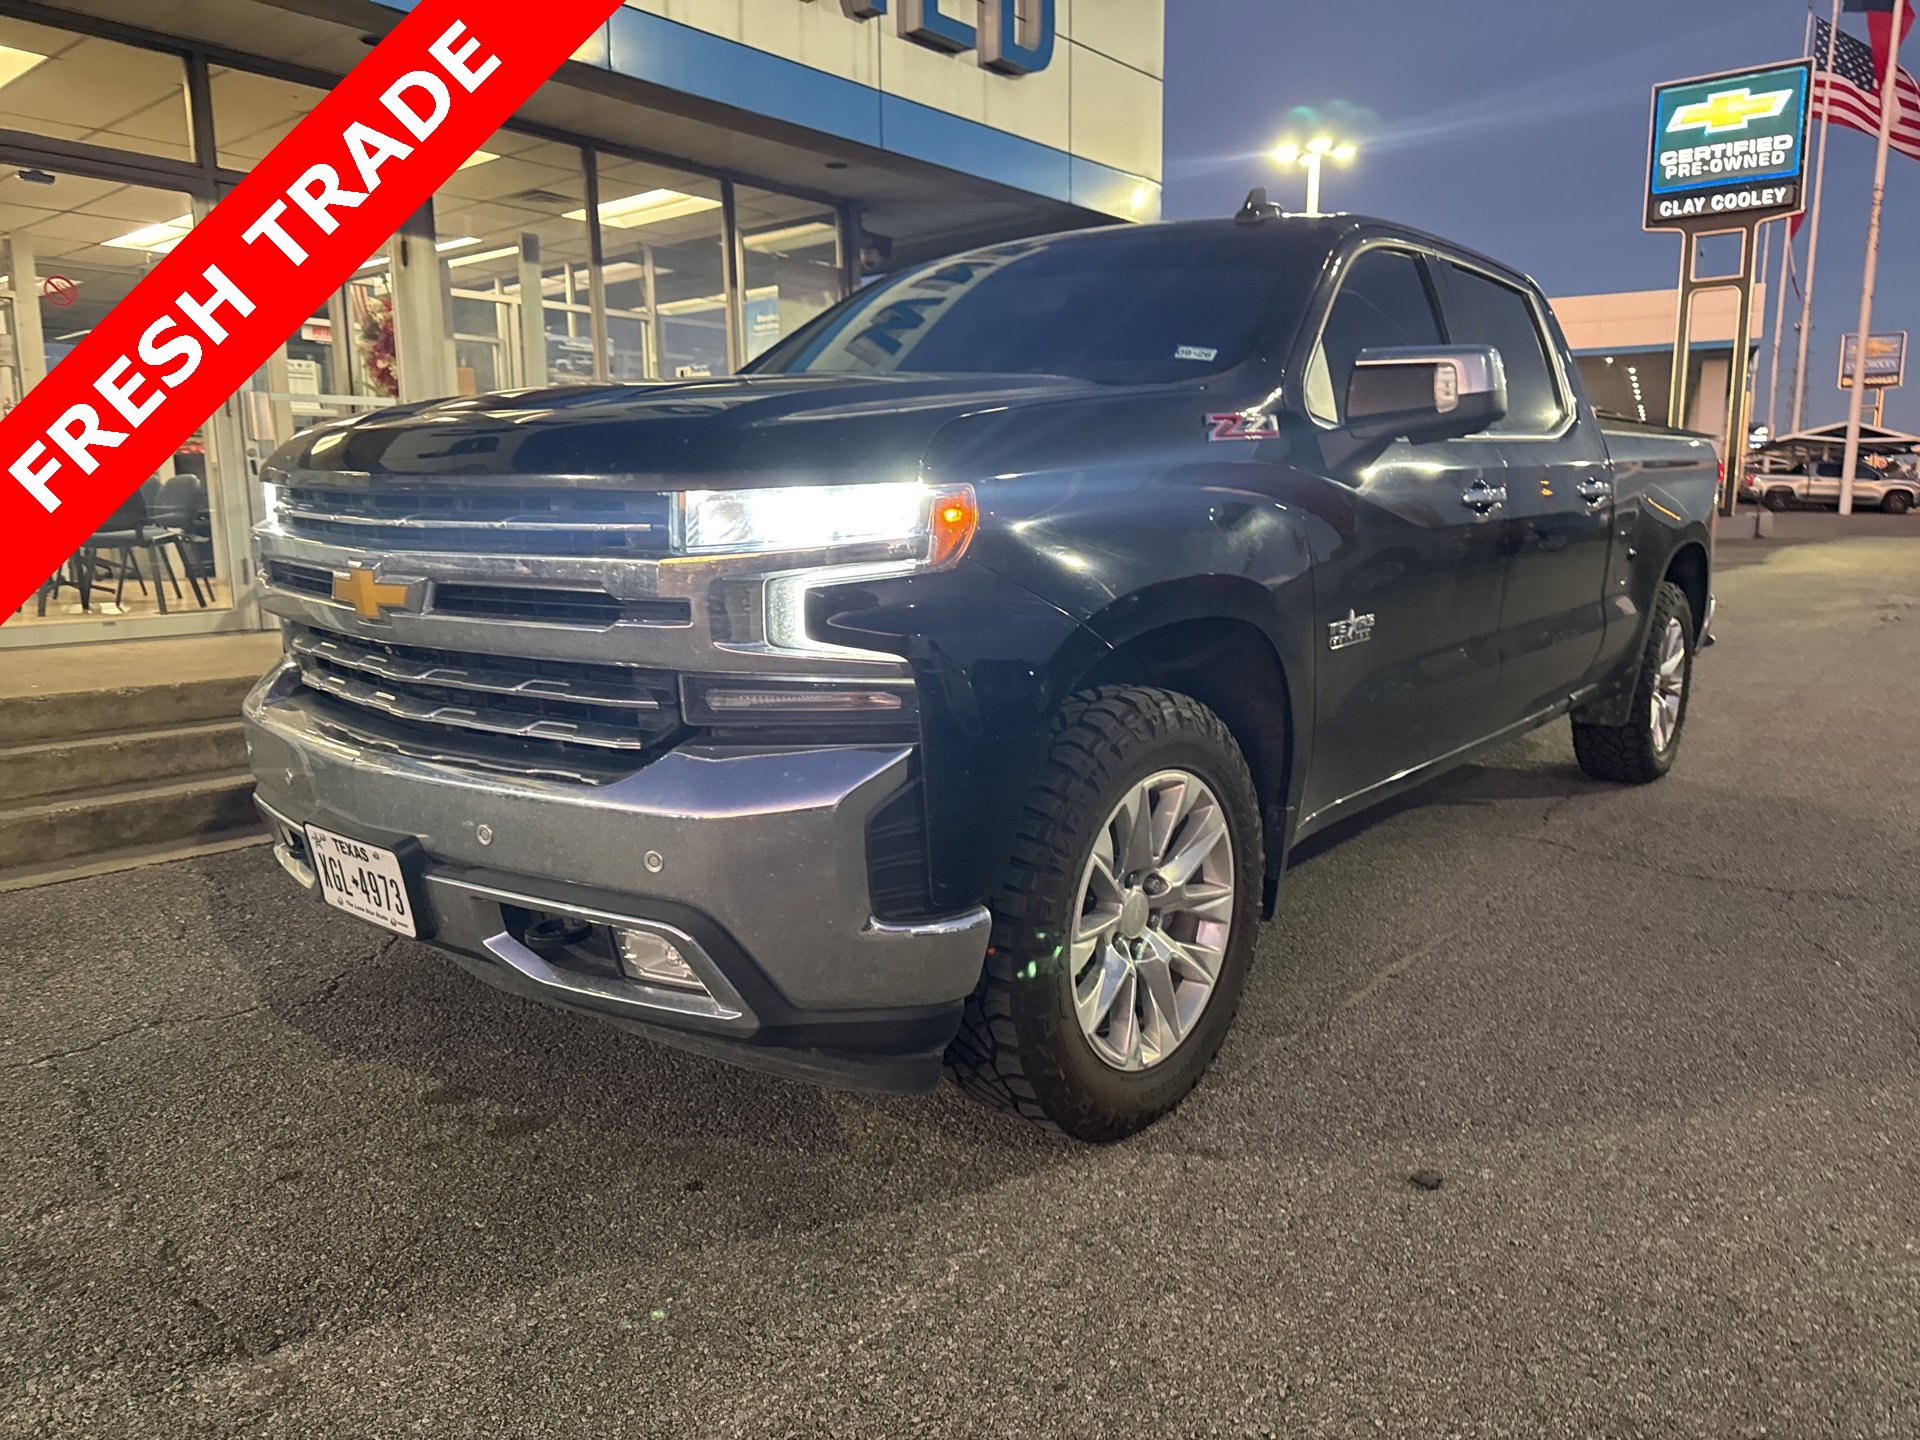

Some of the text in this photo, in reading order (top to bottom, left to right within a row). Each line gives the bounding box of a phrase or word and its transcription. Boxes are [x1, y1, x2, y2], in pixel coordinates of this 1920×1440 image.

[1660, 134, 1794, 166] CERTIFIED
[1665, 150, 1785, 179] PRE-OWNED
[1660, 186, 1786, 217] CLAY COOLEY
[331, 837, 369, 862] TEXAS
